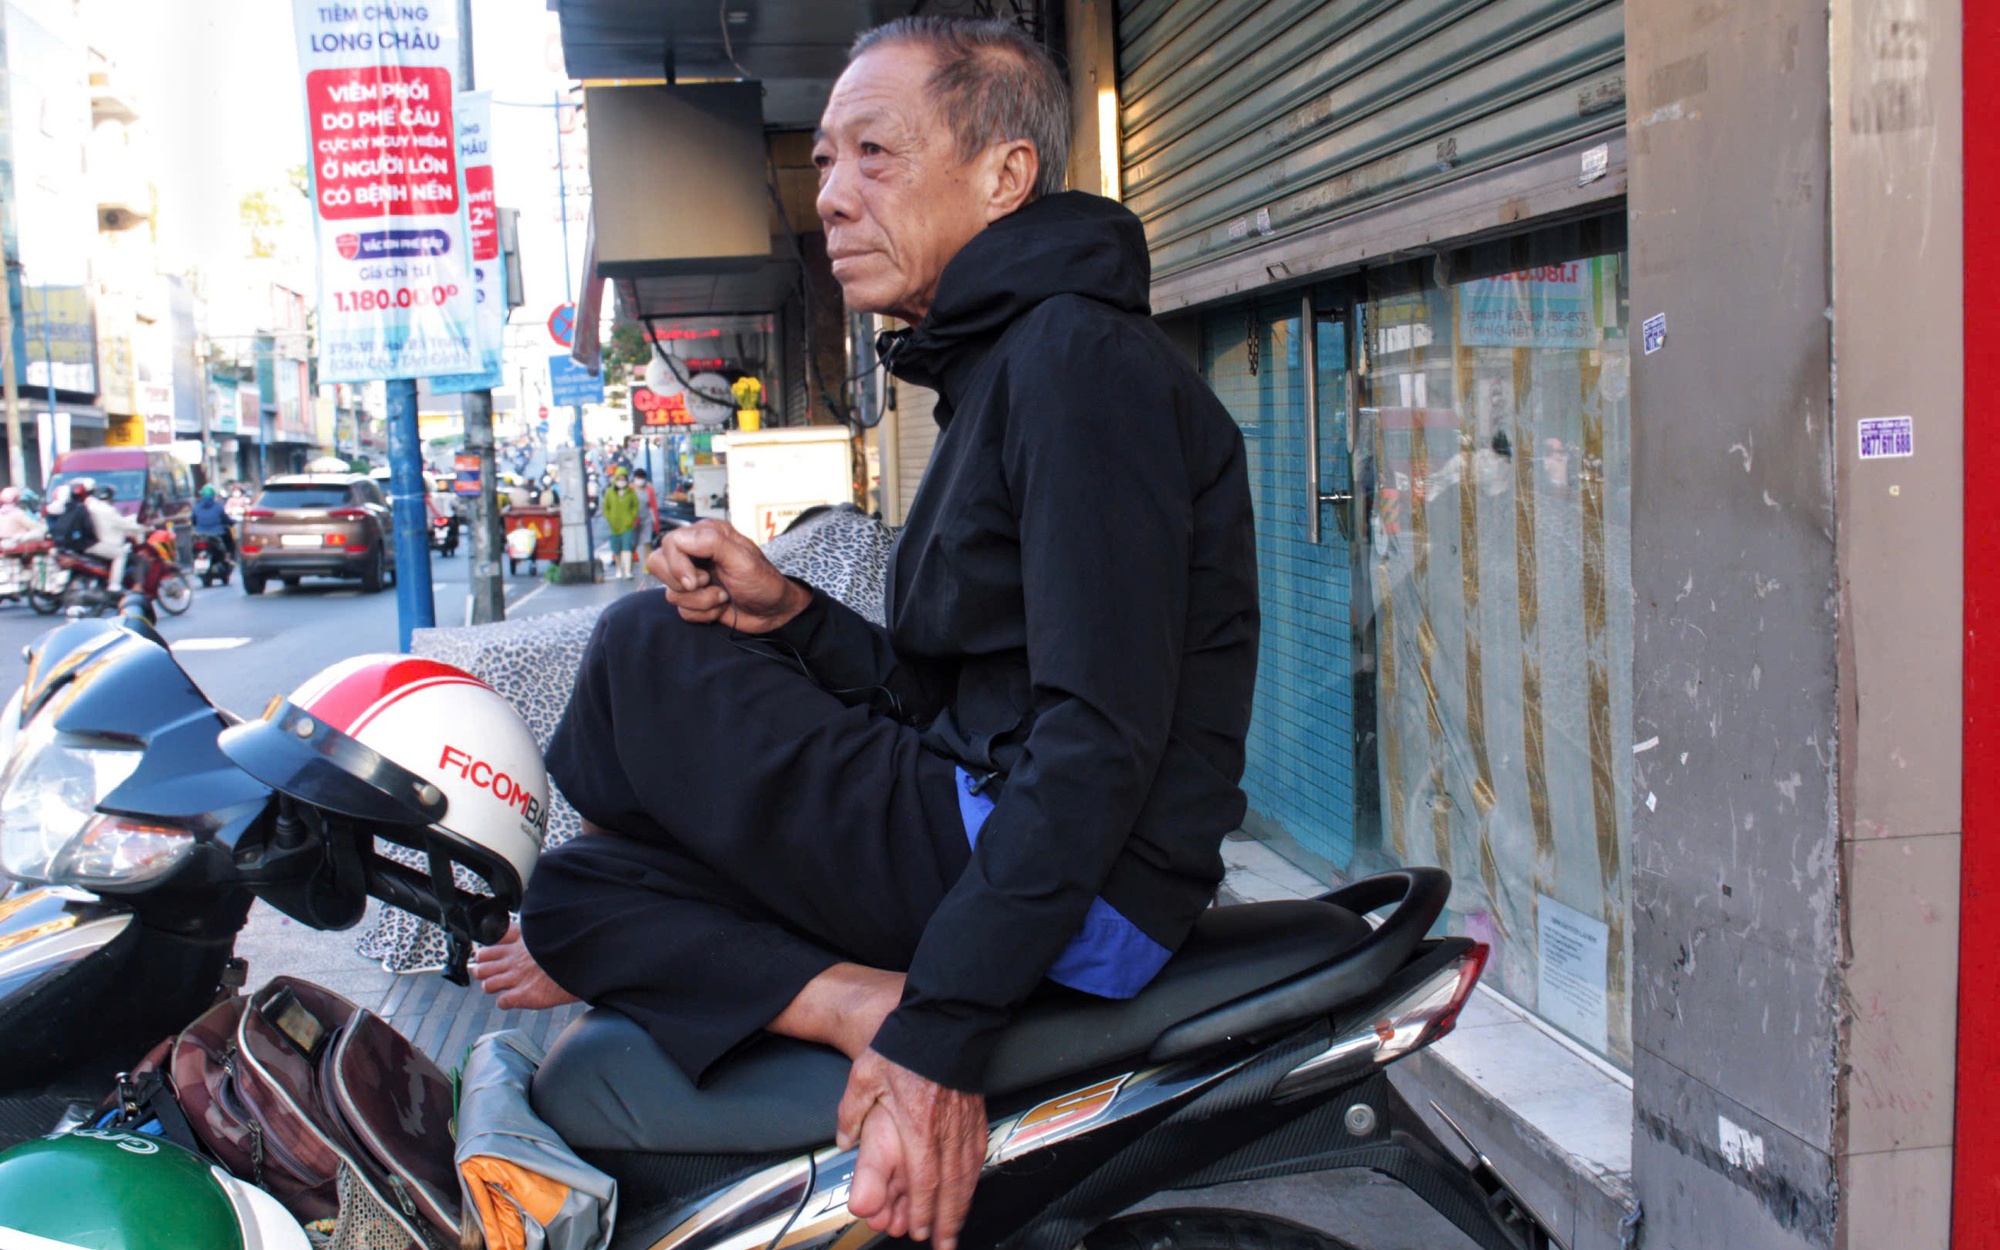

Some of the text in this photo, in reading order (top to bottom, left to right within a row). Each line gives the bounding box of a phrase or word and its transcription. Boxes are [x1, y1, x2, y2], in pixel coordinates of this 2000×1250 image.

[318, 3, 358, 23] TIÊM
[311, 26, 440, 53] LONG CHÂU
[327, 81, 377, 103] VIÊM
[321, 111, 354, 130] DO
[371, 135, 409, 149] NGUY
[322, 185, 352, 206] CÓ
[354, 182, 408, 207] BỆNH
[359, 265, 382, 281] Giá
